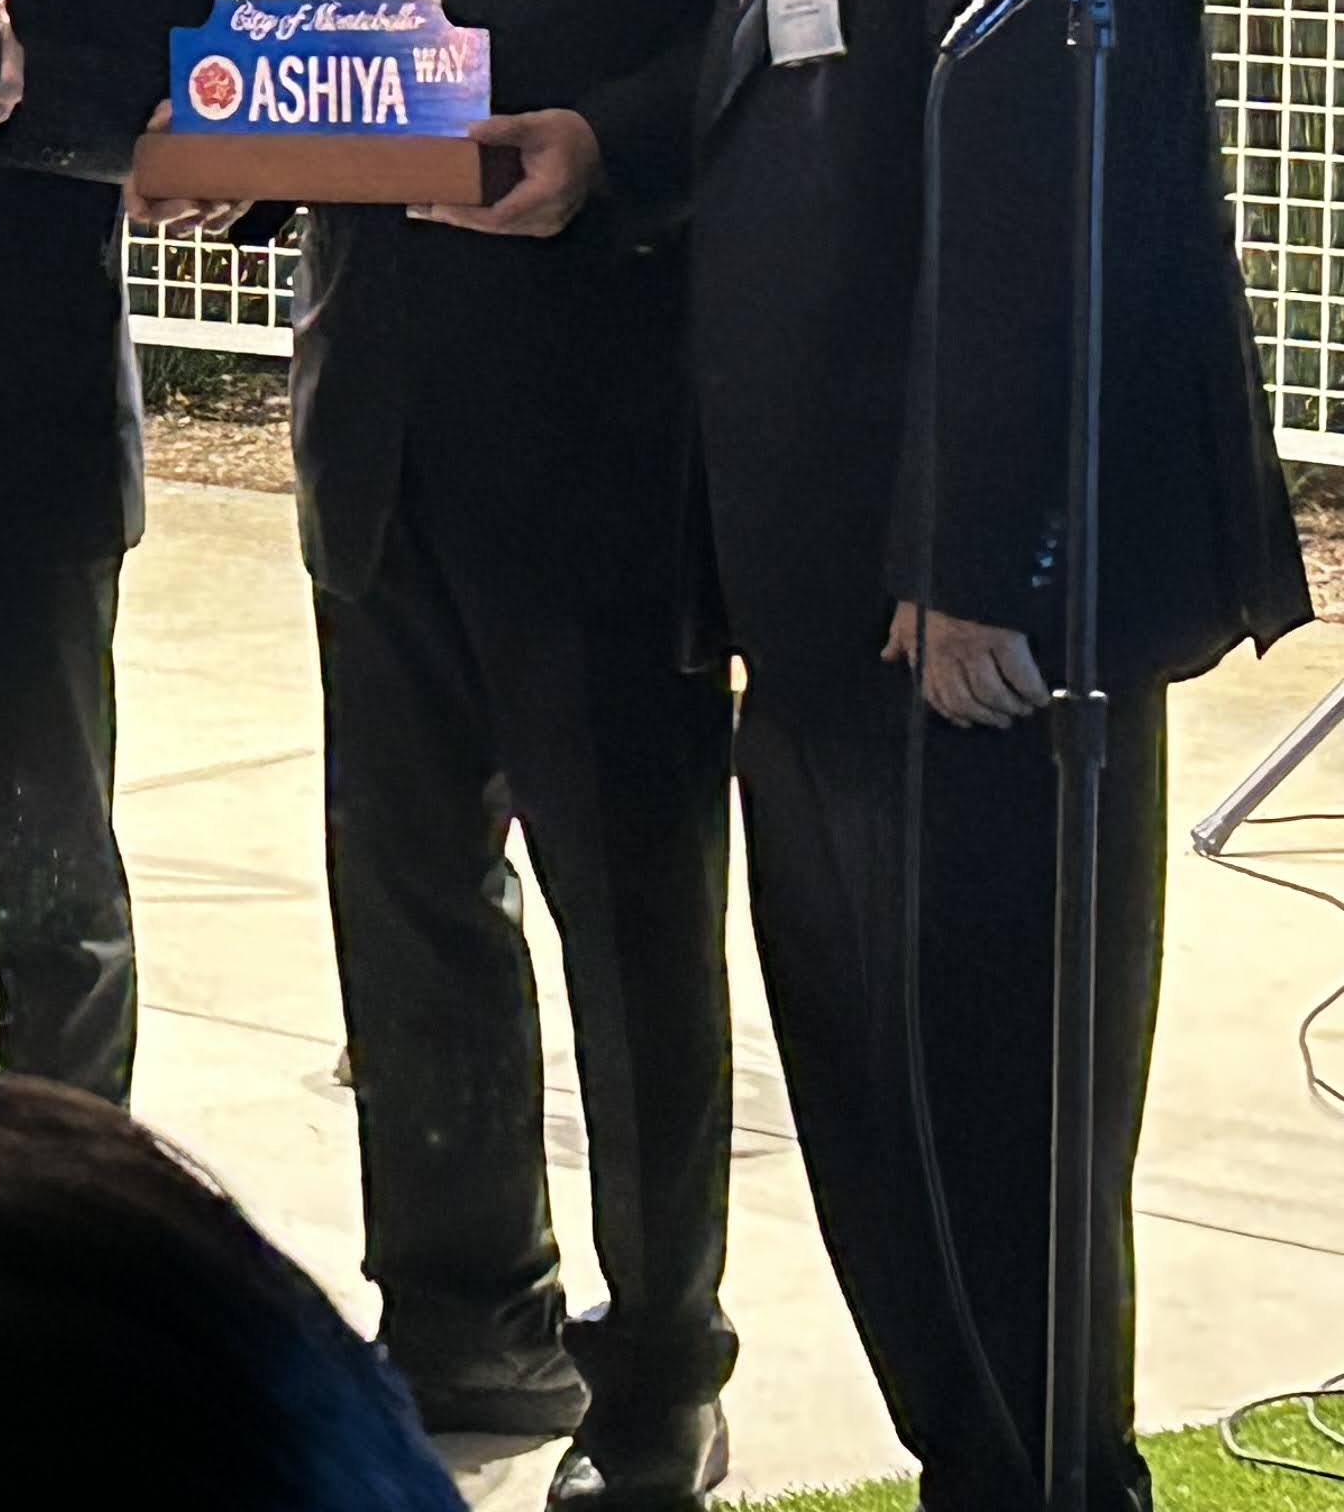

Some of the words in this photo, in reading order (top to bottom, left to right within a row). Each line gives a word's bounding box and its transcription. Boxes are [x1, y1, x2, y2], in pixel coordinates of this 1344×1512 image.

[230, 0, 279, 41] City
[275, 3, 313, 41] of
[248, 55, 409, 125] ASHIYA
[412, 44, 469, 84] WAY
